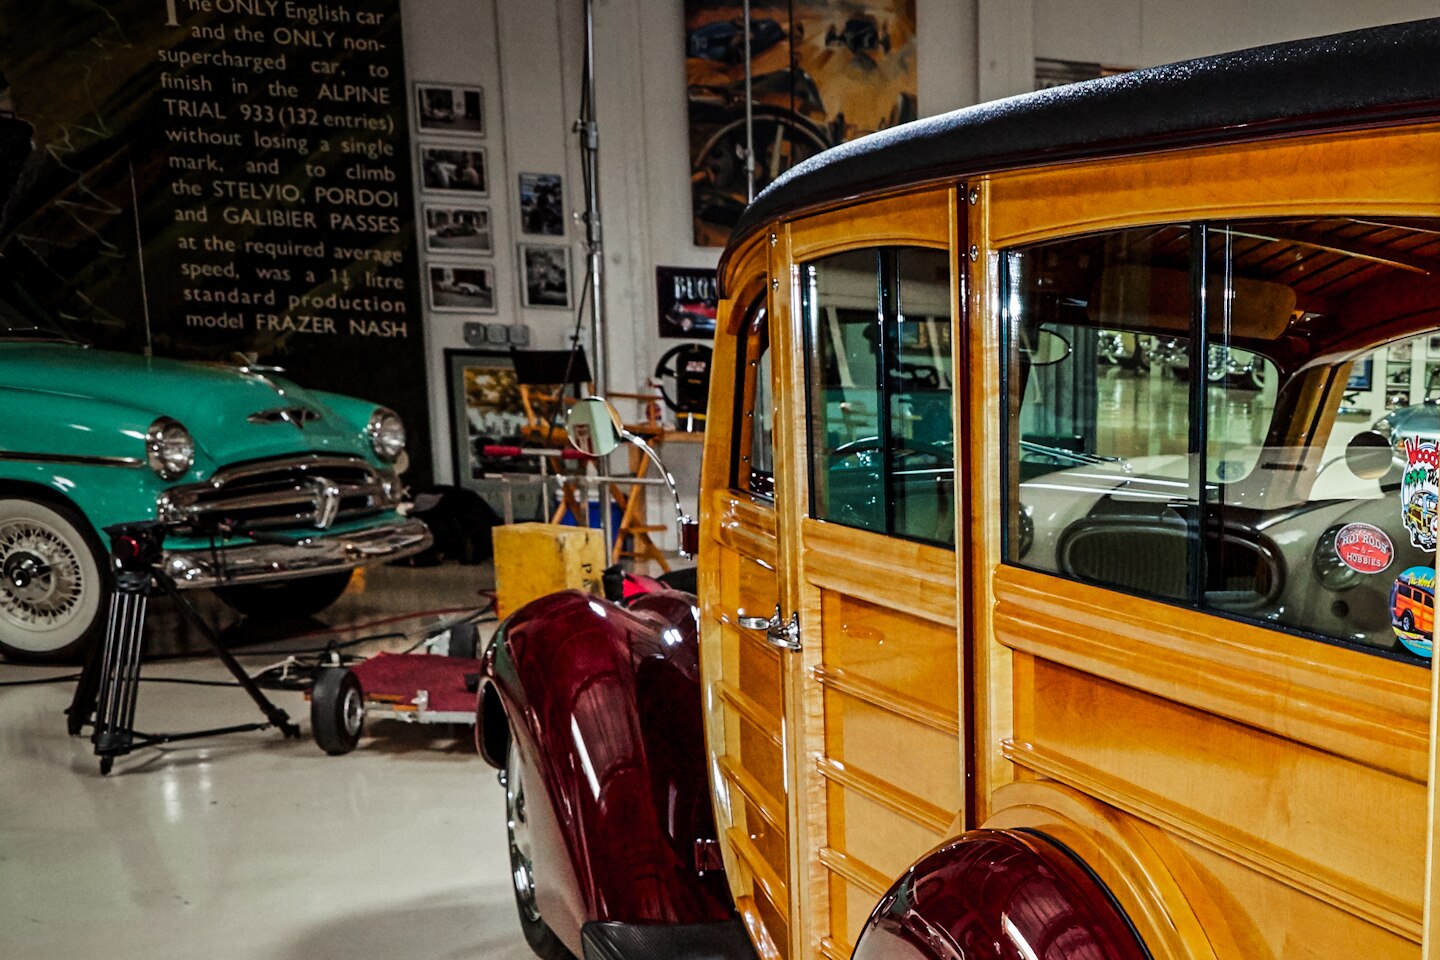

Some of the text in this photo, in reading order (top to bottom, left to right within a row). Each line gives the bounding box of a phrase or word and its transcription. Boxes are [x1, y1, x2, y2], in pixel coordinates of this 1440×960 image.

[216, 0, 278, 17] ONLY
[286, 1, 350, 25] English
[356, 10, 385, 25] car
[191, 23, 387, 51] and the ONLY non-
[158, 49, 286, 73] supercharged
[368, 63, 389, 78] to
[160, 73, 390, 104] finish in the ALPINE
[163, 98, 226, 120] TRIAL
[279, 107, 318, 127] (132
[323, 113, 394, 135] entries)
[166, 128, 394, 160] without losing a single
[246, 158, 279, 175] and
[305, 162, 326, 177] to
[345, 163, 395, 182] climb
[172, 180, 202, 196] the
[315, 186, 398, 207] PORDOI
[174, 206, 401, 233] and GALIBIER PASSES
[178, 235, 403, 267] at the required average
[256, 267, 291, 281] was
[306, 270, 315, 282] a
[365, 270, 404, 289] litre
[184, 286, 406, 312] standard production
[186, 312, 408, 338] model FRAZER NASH
[1362, 533, 1388, 554] RODS
[1346, 552, 1381, 567] HOBBIES
